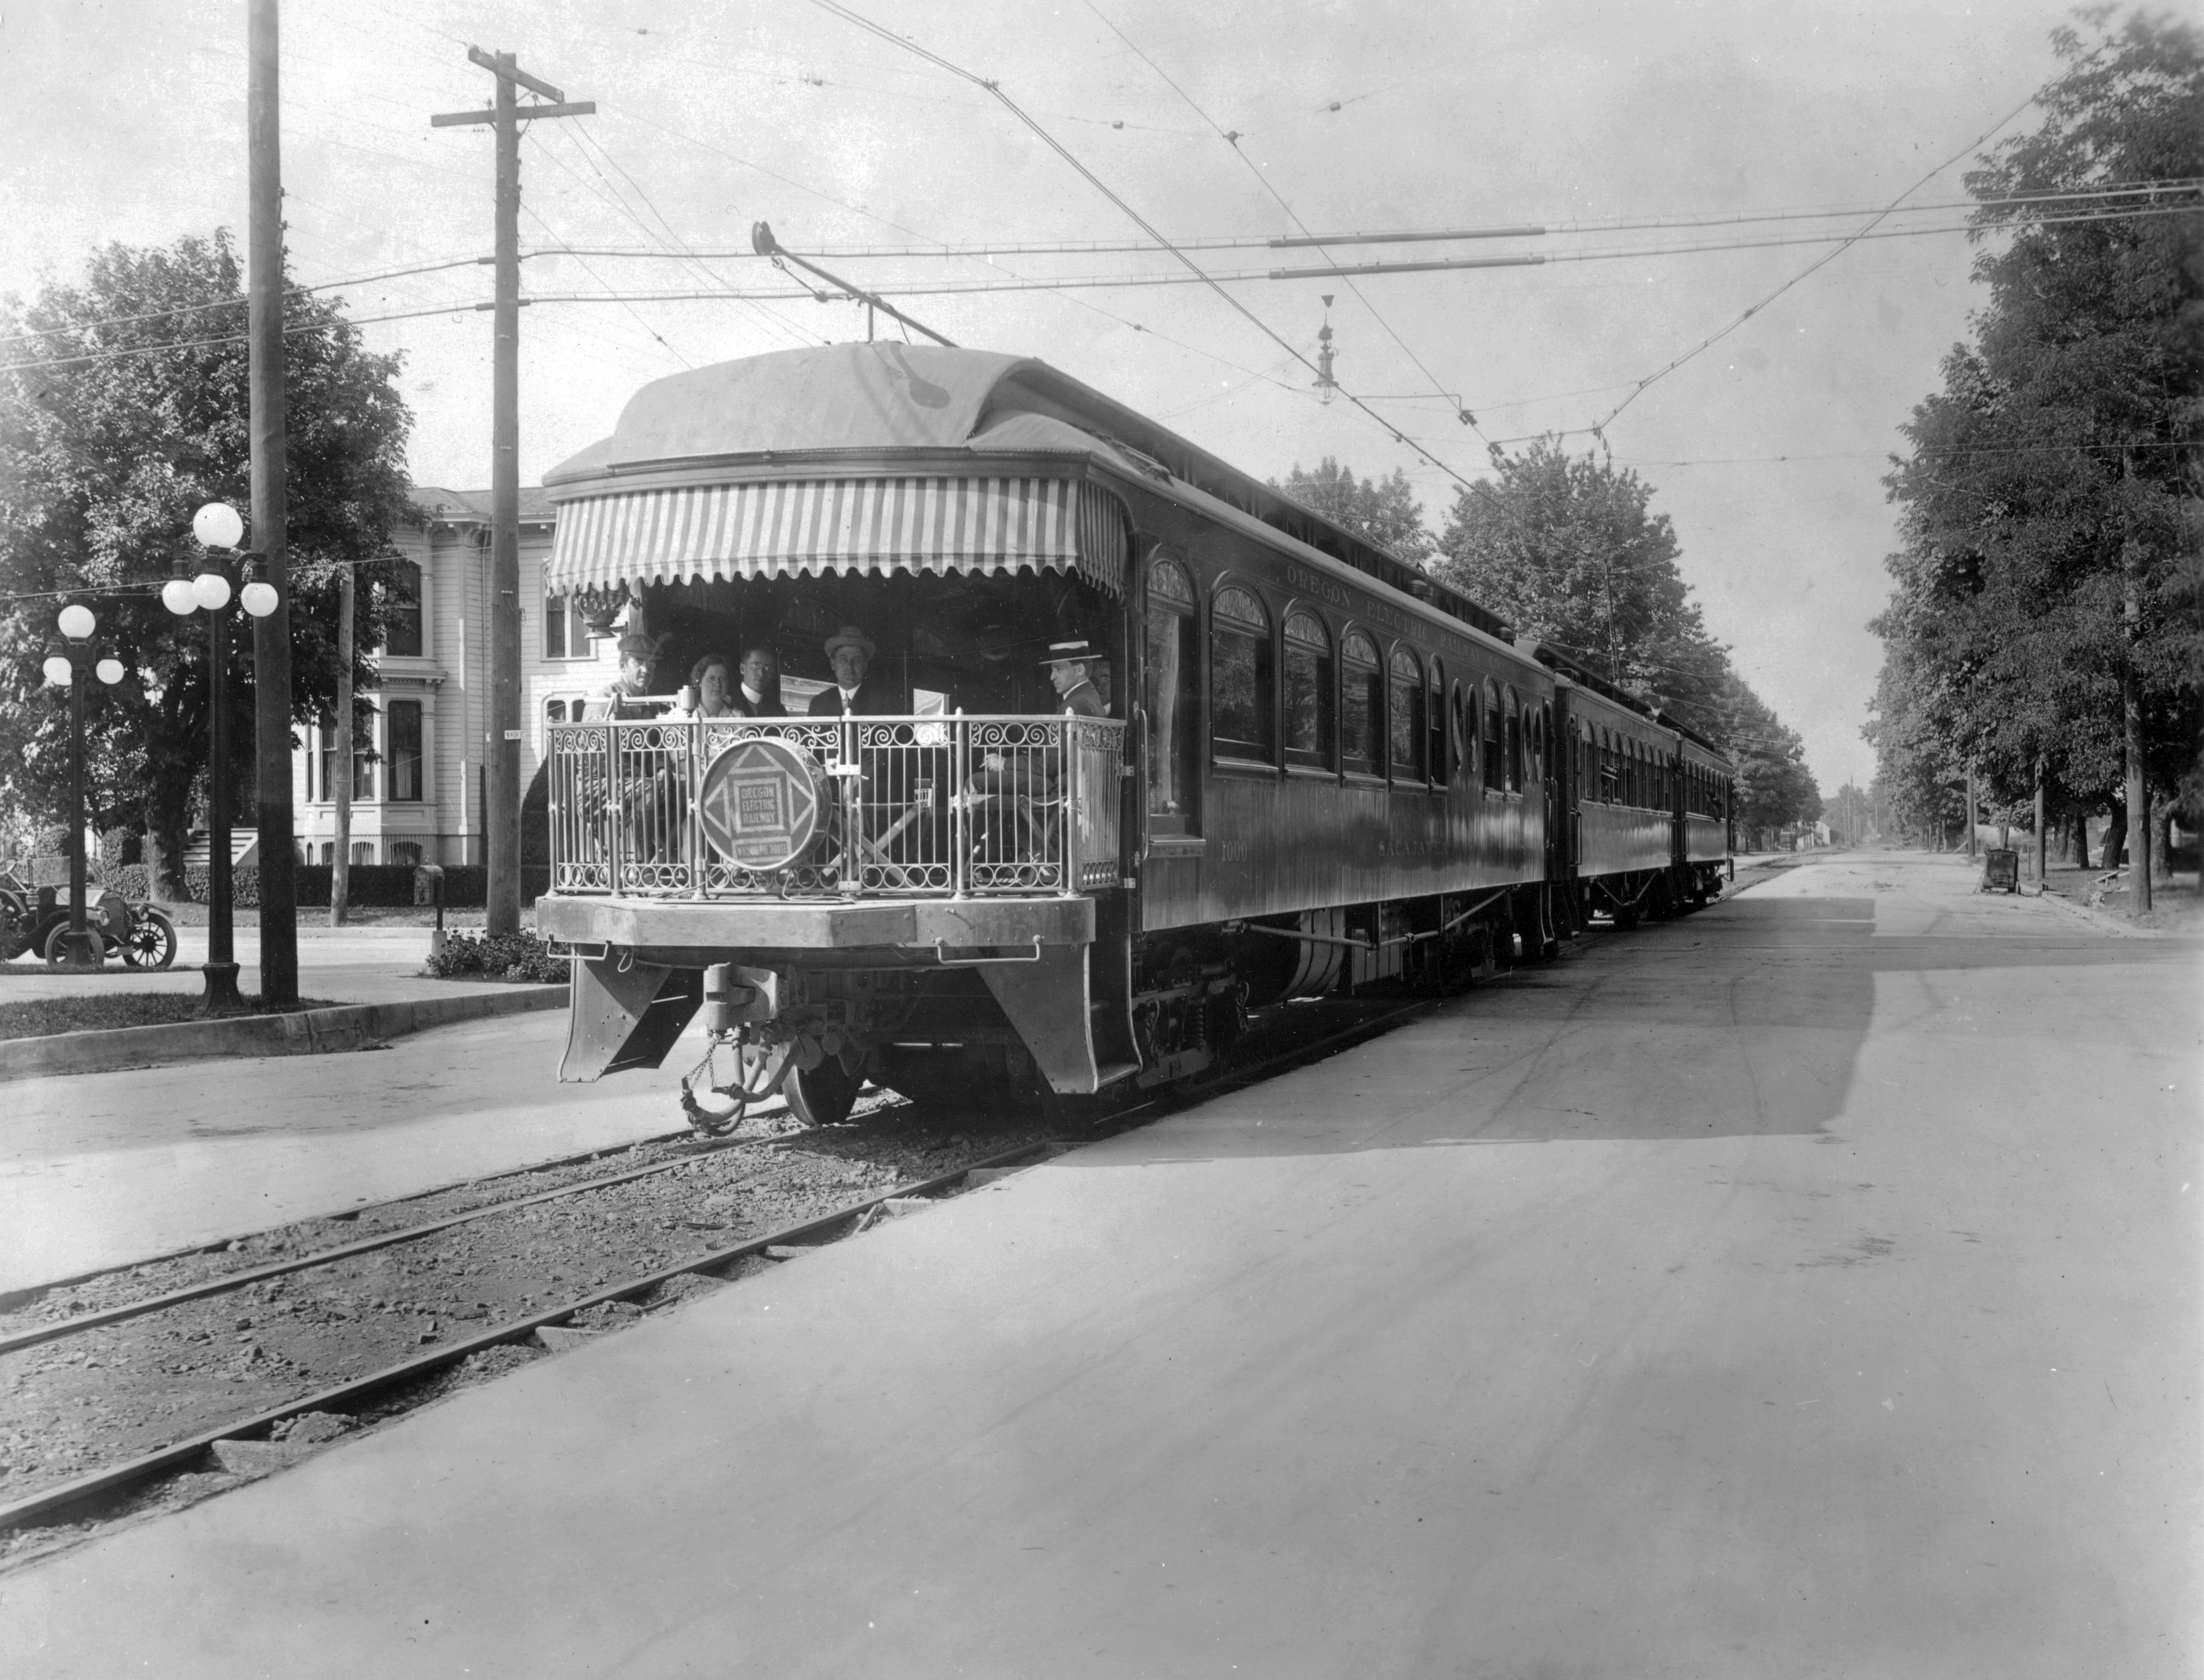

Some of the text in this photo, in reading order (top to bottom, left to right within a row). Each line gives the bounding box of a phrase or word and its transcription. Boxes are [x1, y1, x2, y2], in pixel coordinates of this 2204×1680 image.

[1287, 566, 1351, 607] OREGON
[1367, 601, 1428, 640] ELECTRIC
[1440, 634, 1480, 663] RAILWAY
[741, 786, 775, 799] OREGON
[742, 799, 775, 812] ELECTRIC
[743, 811, 776, 824] RAILWAY
[1221, 840, 1247, 862] 1000
